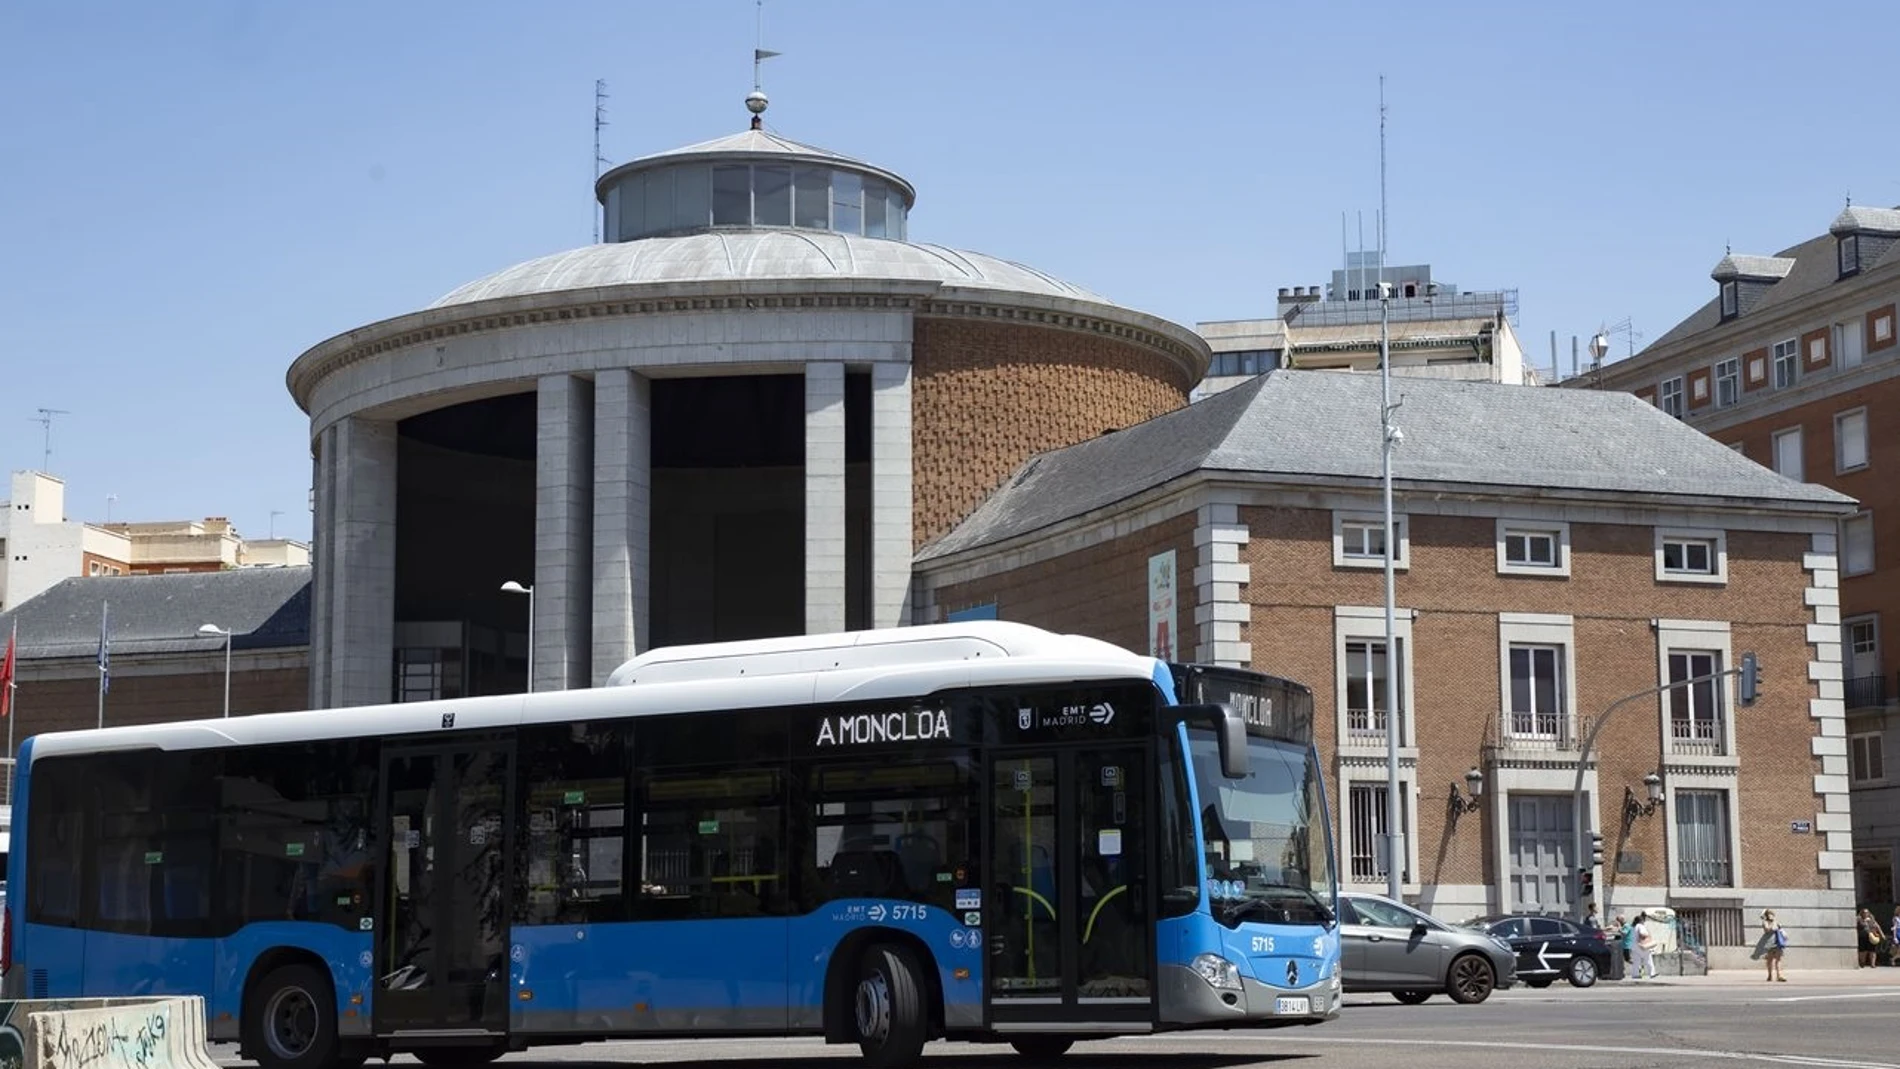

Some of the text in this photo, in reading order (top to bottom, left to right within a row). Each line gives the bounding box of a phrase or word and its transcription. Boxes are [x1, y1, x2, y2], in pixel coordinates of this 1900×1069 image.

[1062, 705, 1086, 716] EMT
[816, 709, 950, 746] A MONCLOA
[1042, 715, 1087, 727] MADRID
[847, 905, 866, 913] EMT
[892, 905, 927, 920] 5715
[1251, 936, 1275, 952] 5715
